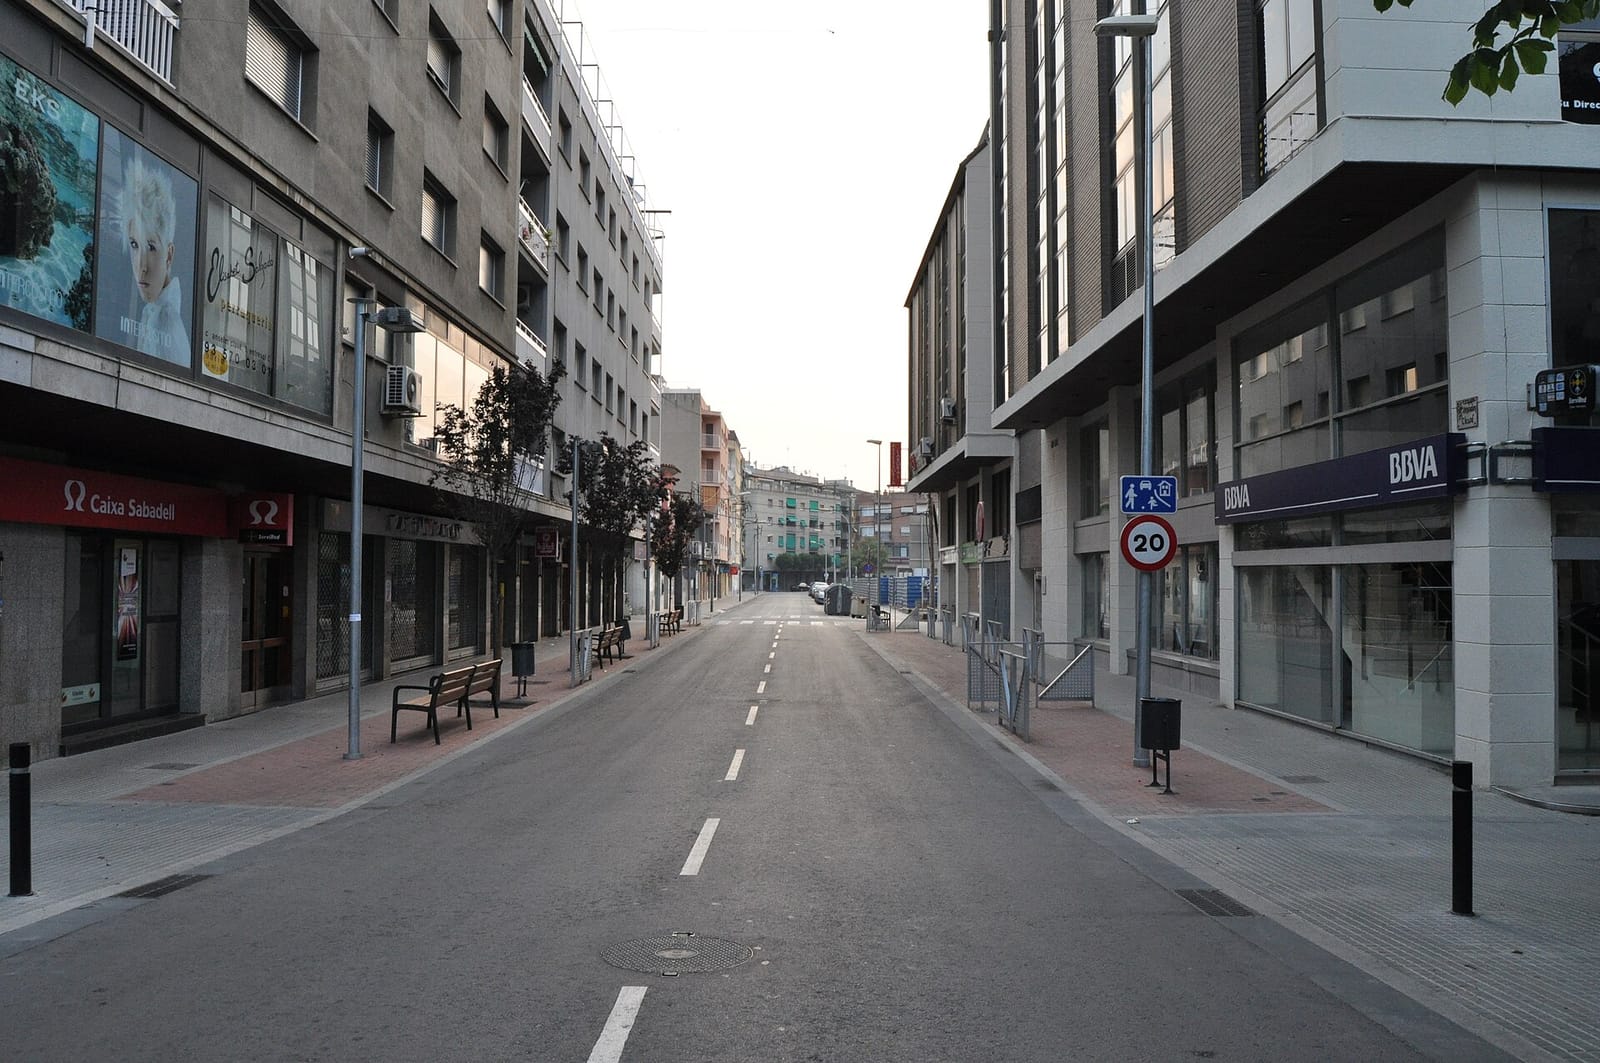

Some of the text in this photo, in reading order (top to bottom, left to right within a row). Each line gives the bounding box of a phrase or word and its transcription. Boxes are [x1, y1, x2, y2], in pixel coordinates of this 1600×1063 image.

[1390, 445, 1438, 485] BBVA
[90, 495, 175, 521] Caixa Sabadell
[1224, 484, 1250, 511] BBVA
[1133, 533, 1165, 553] 20
